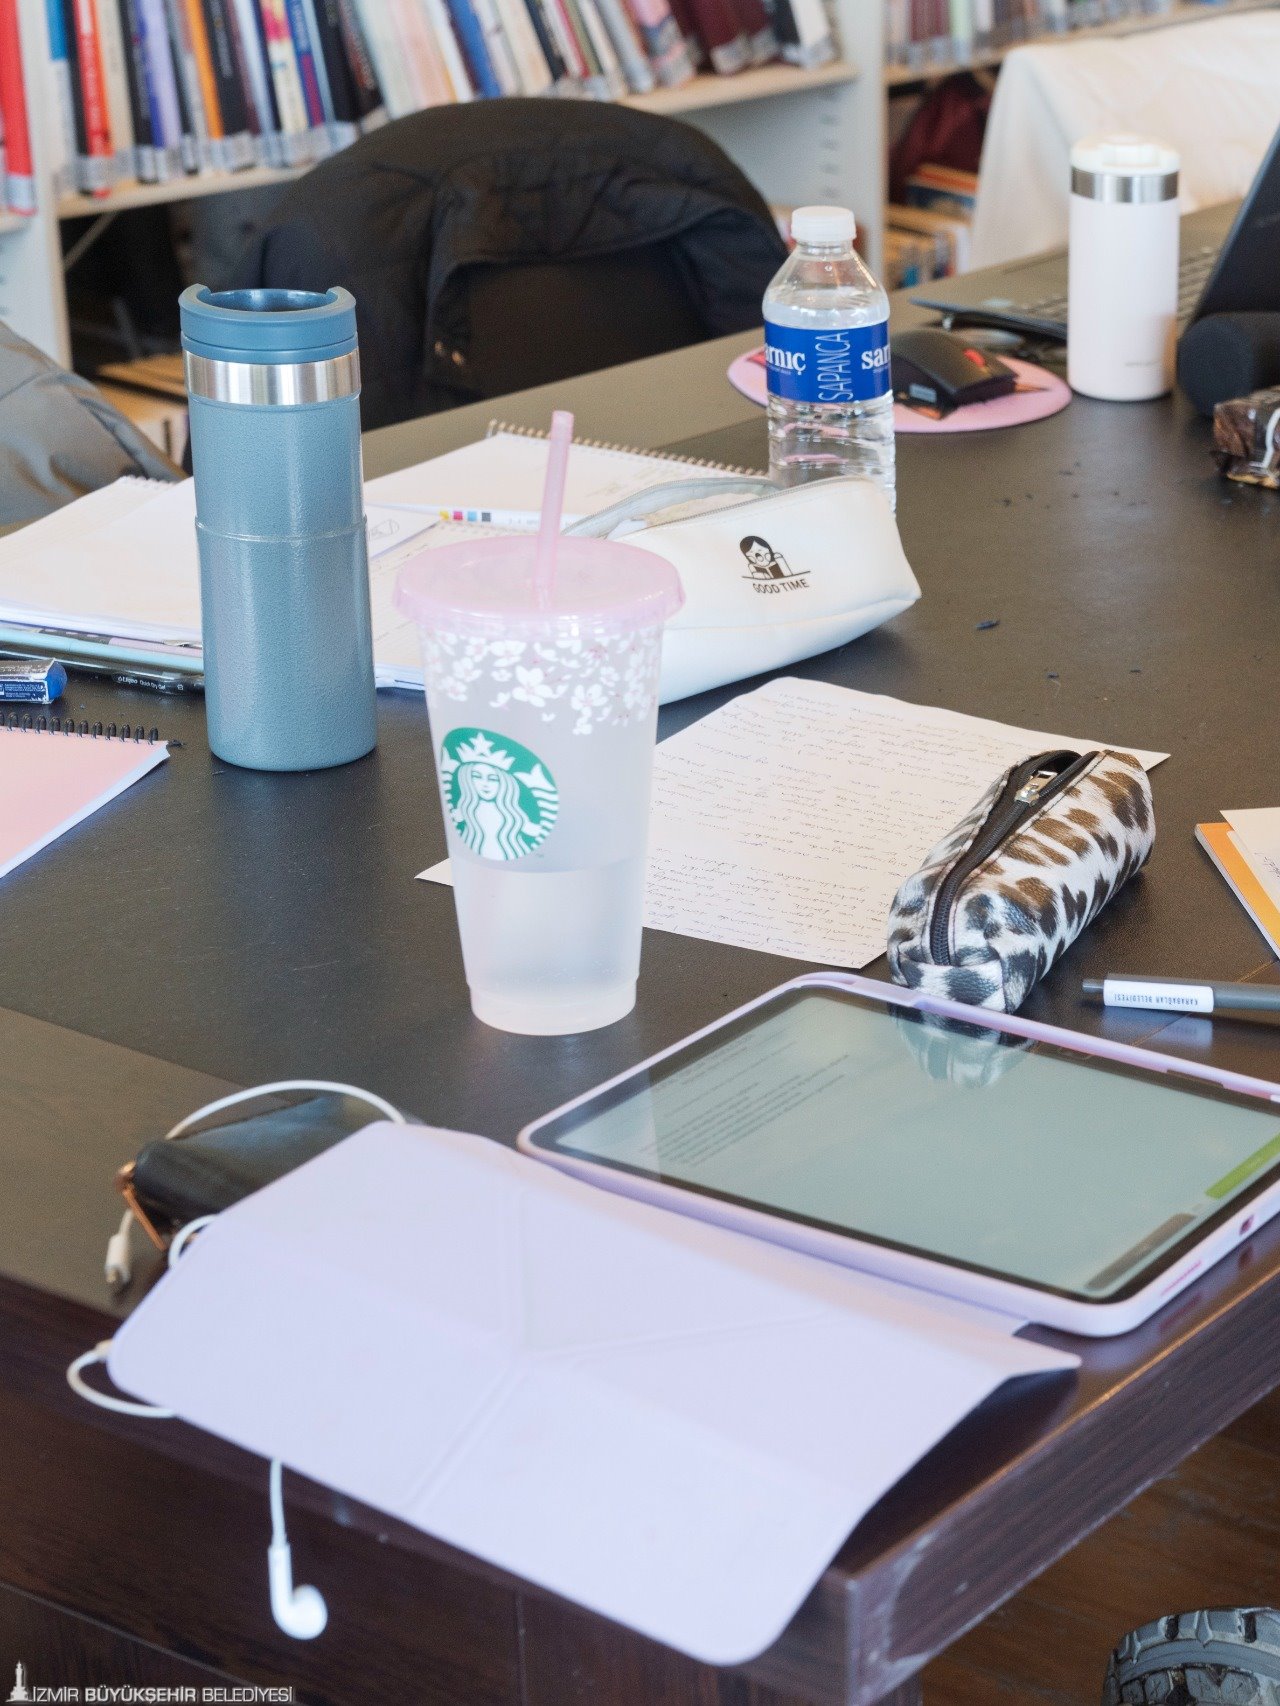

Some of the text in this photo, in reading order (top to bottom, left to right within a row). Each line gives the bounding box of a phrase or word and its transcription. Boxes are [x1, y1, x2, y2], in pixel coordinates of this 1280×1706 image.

[815, 331, 854, 401] SAPANCA
[861, 344, 892, 371] sar
[752, 578, 810, 594] GOOD TIME
